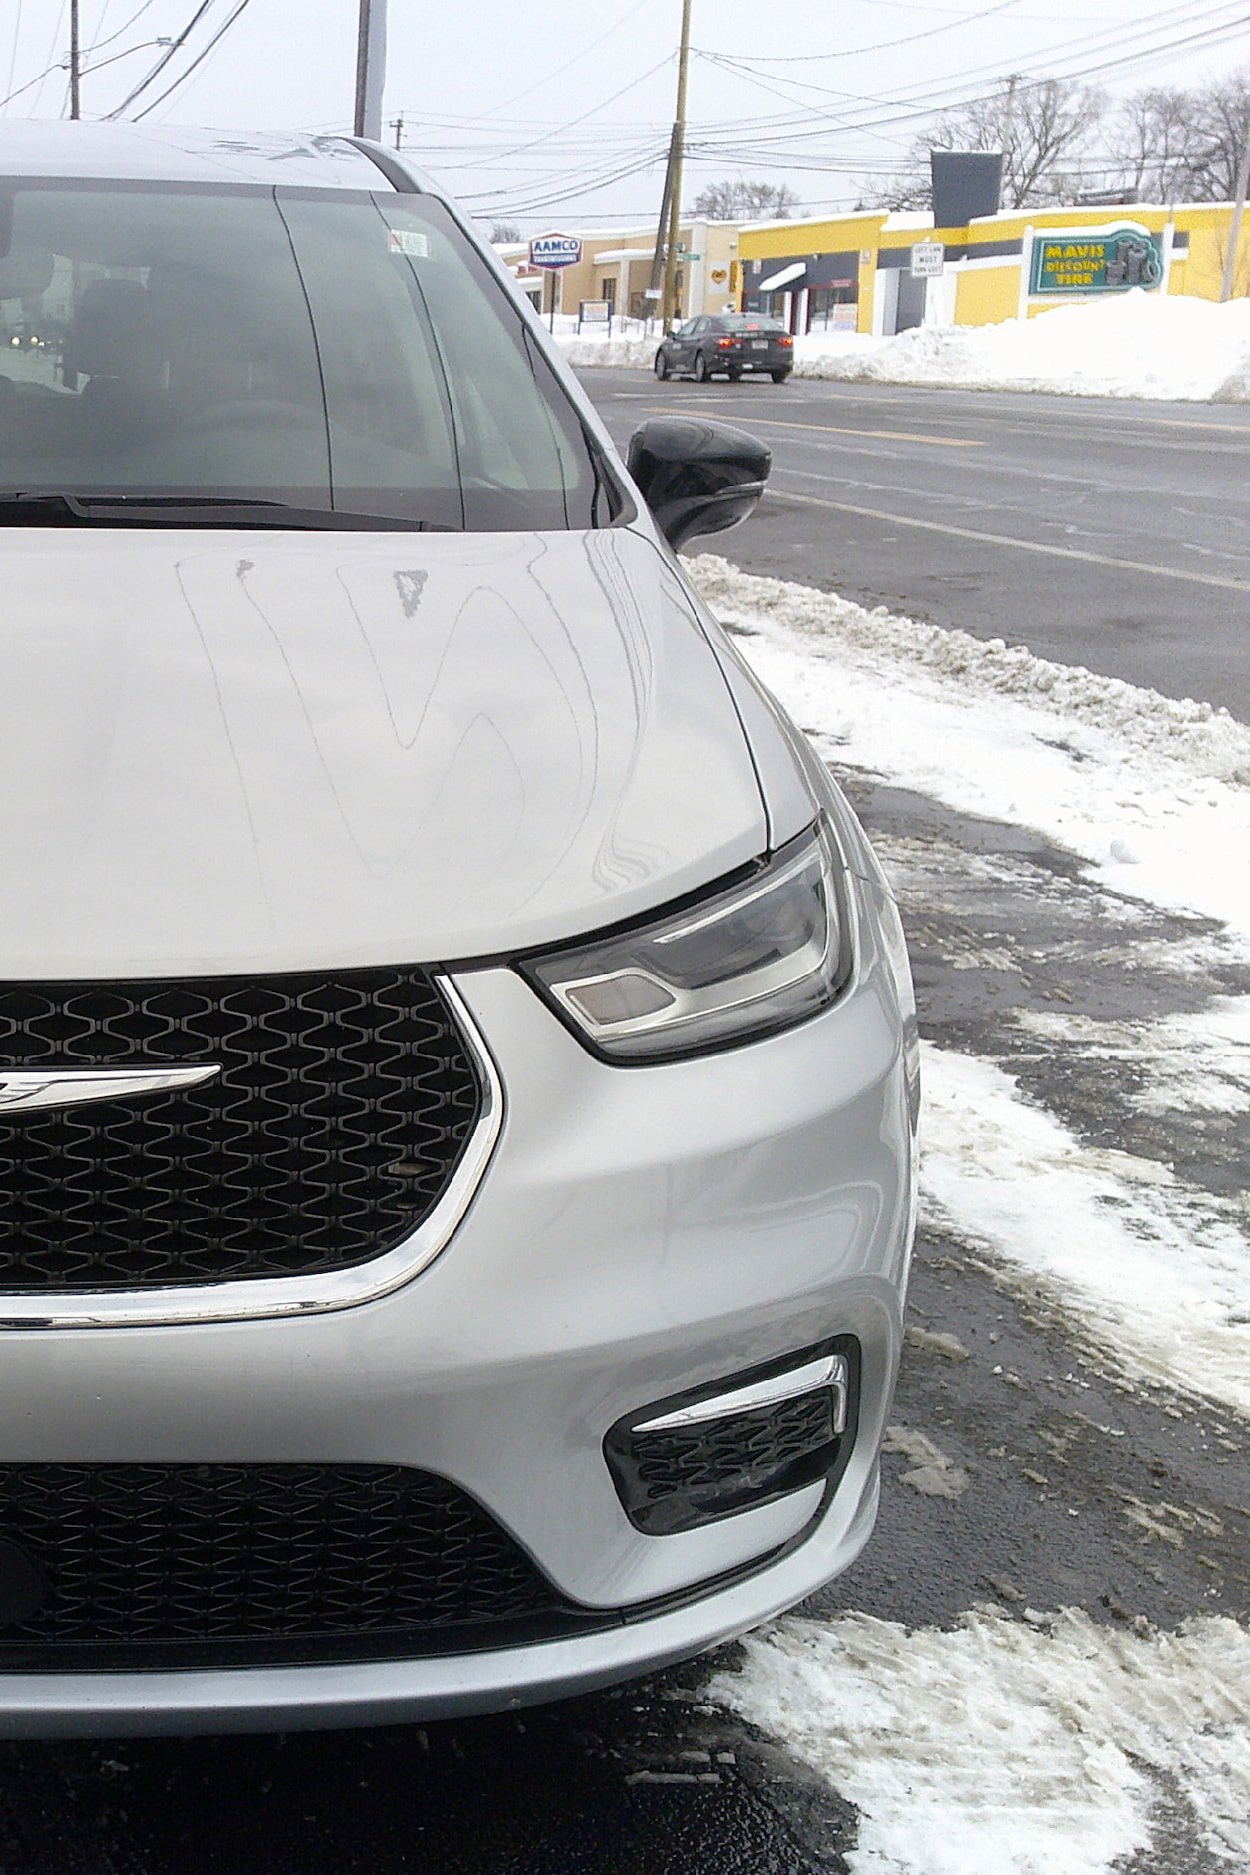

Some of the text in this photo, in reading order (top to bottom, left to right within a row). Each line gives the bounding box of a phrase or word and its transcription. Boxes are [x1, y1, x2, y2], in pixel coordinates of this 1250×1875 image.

[534, 240, 578, 252] AAMCO
[1045, 244, 1104, 259] MAVIS
[1056, 273, 1092, 285] TIRE
